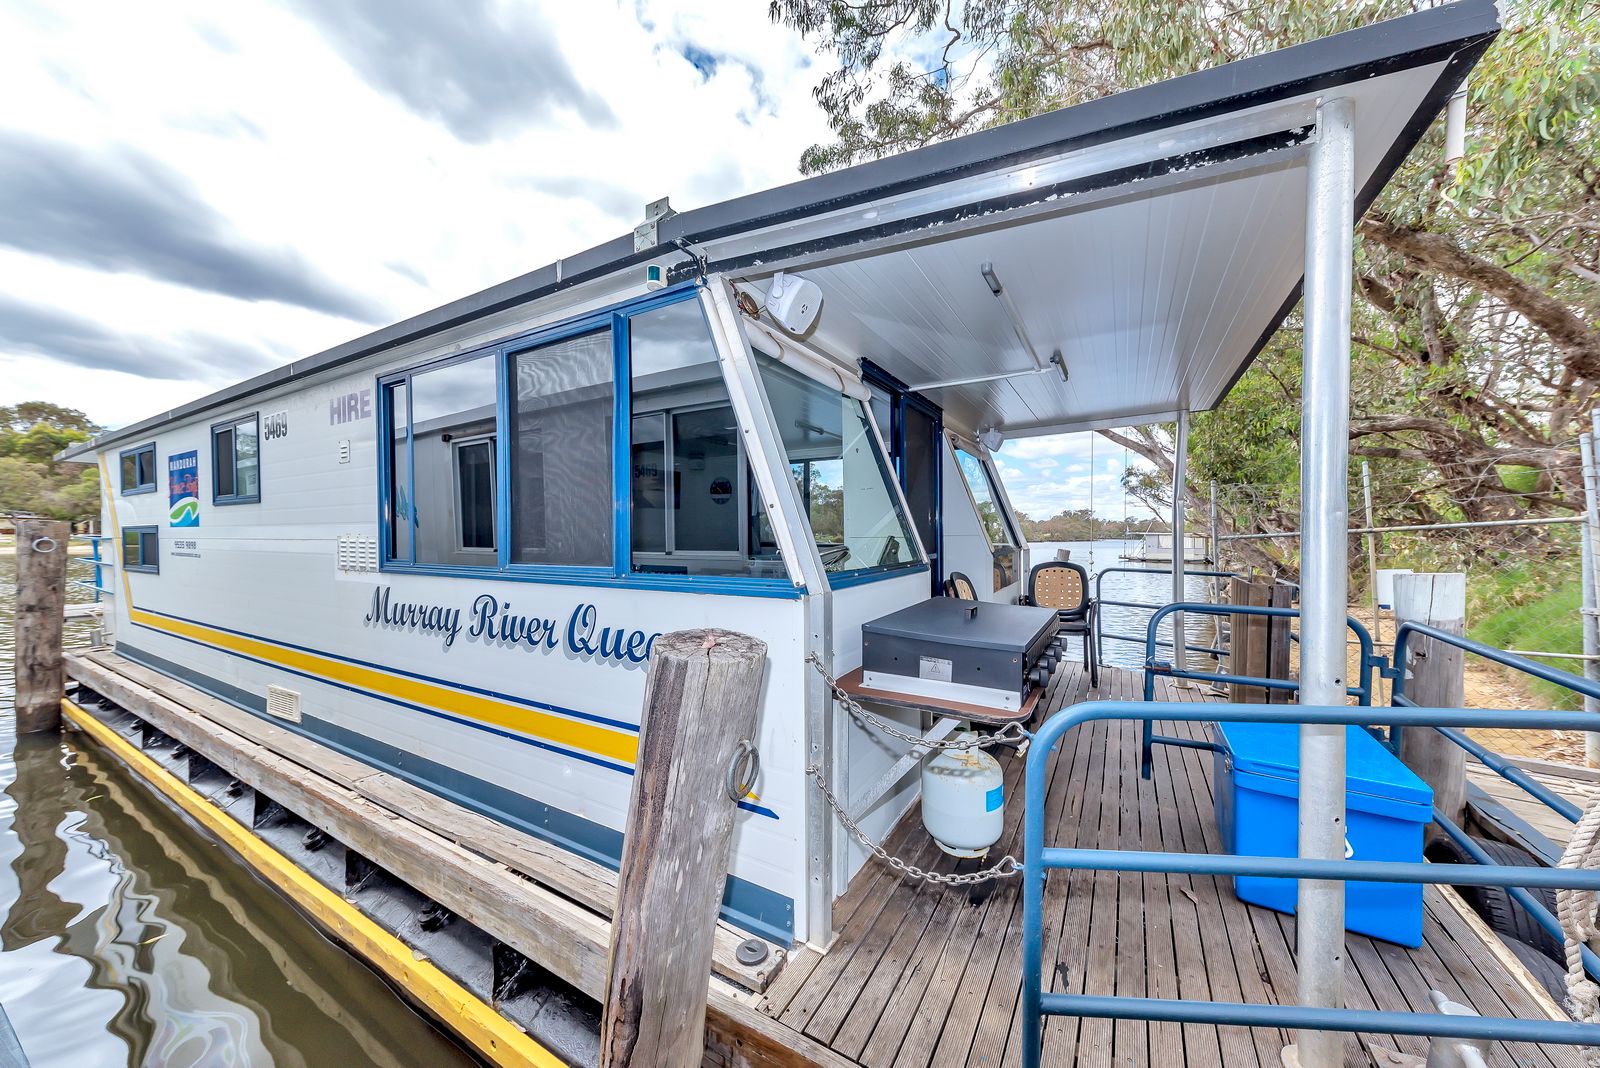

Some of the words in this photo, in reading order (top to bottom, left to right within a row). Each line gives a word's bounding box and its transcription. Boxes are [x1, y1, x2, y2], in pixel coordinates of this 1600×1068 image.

[264, 412, 287, 440] 5469
[330, 389, 371, 426] HIRE
[366, 586, 462, 647] Murray
[469, 594, 559, 650] River
